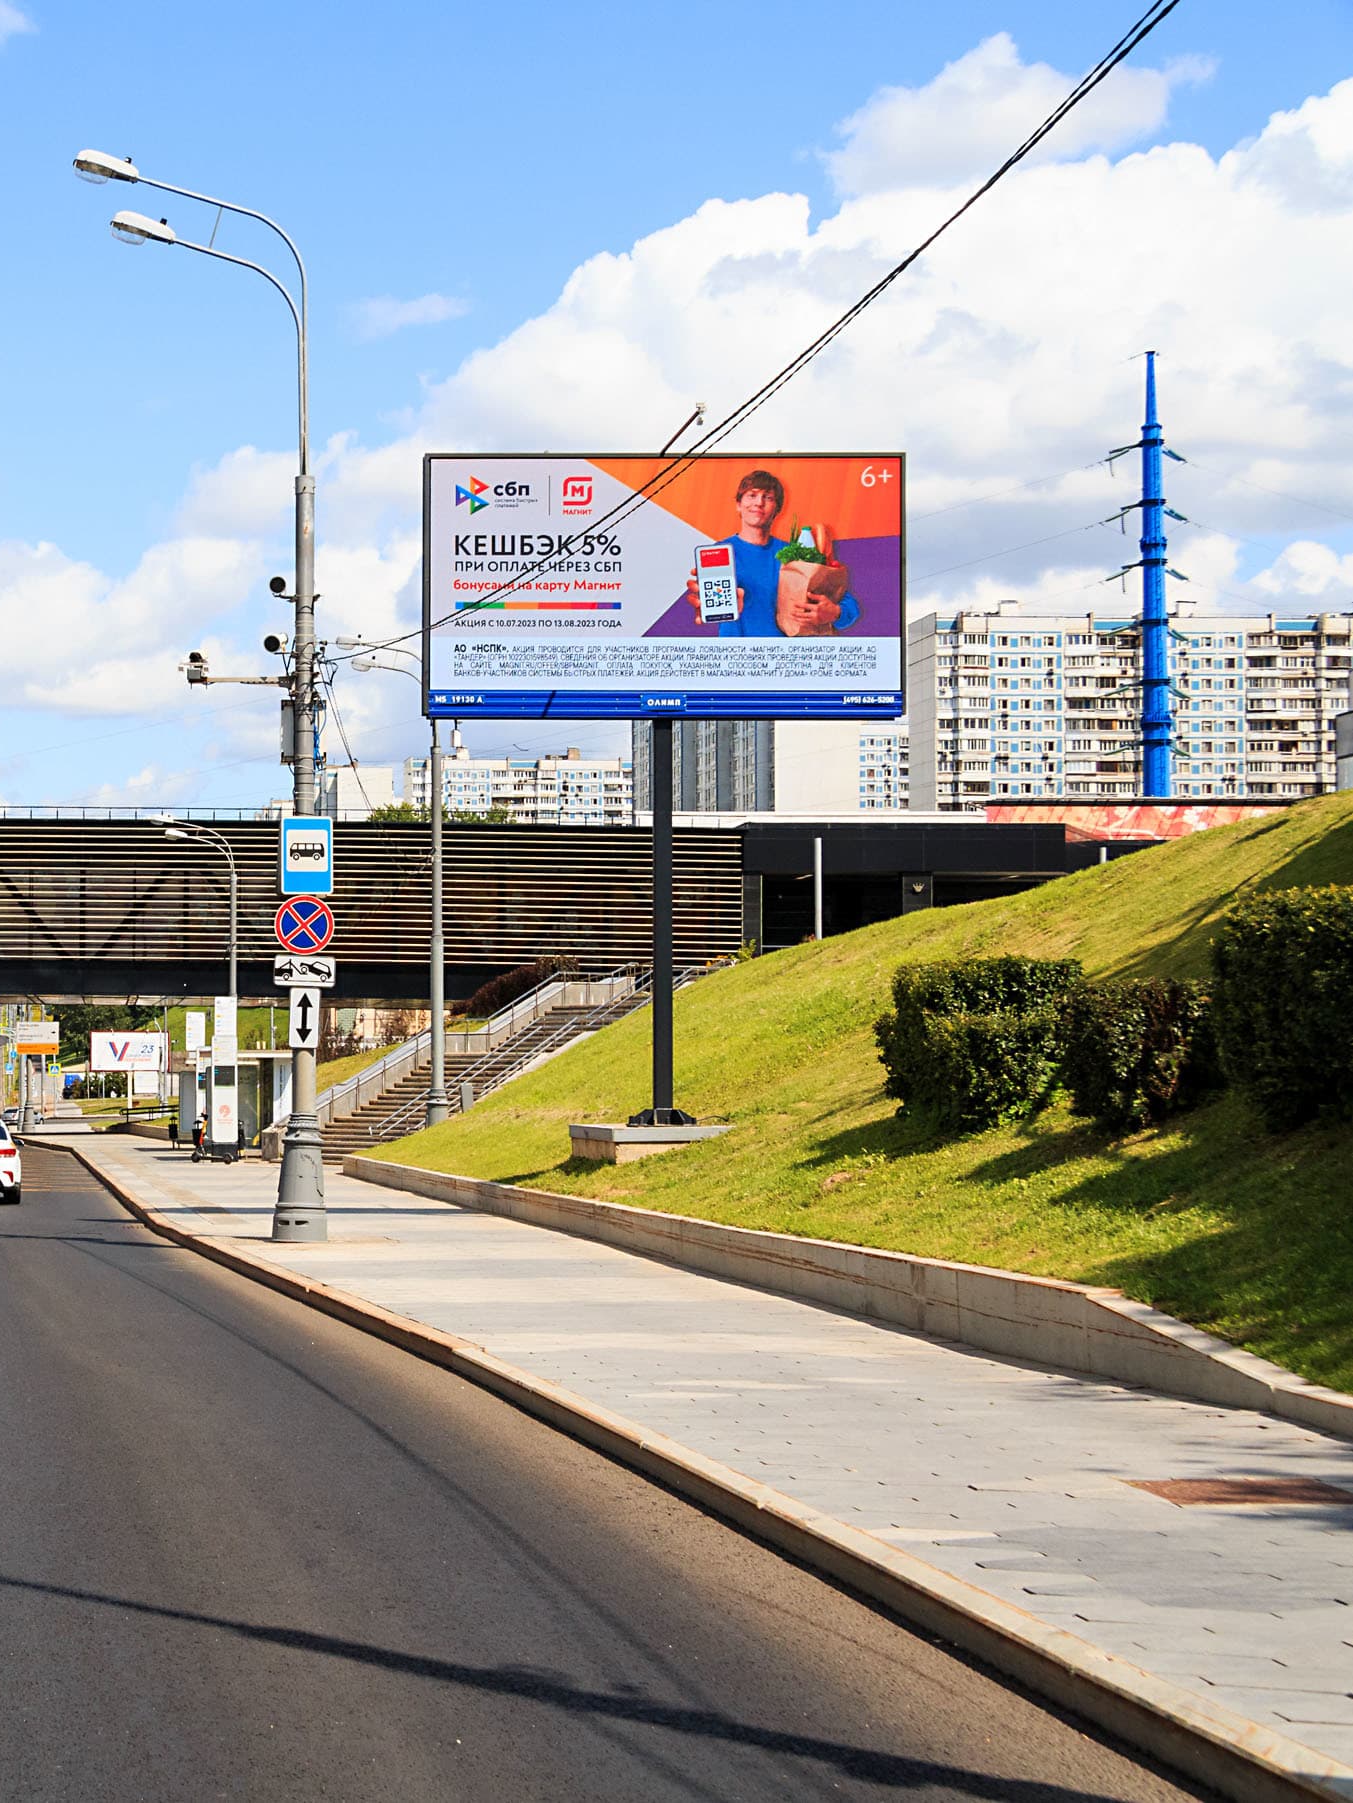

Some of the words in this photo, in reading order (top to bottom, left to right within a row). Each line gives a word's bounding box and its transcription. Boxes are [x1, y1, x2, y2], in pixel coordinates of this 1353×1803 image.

[861, 466, 893, 487] 6+
[493, 481, 530, 497] сбп
[454, 535, 574, 556] КЕШБЭК
[581, 535, 622, 556] 5%
[455, 561, 483, 572] ПРИ
[487, 561, 545, 572] ОПЛАТЕ
[548, 561, 590, 572] ЧЕРЕЗ
[594, 561, 622, 572] СБП
[453, 579, 515, 592] бонусами
[518, 582, 532, 590] на
[535, 582, 571, 592] карту
[573, 580, 622, 590] Магнит
[454, 620, 487, 628] АКЦИЯ
[598, 620, 622, 628] ГОДА
[454, 644, 467, 653] АО
